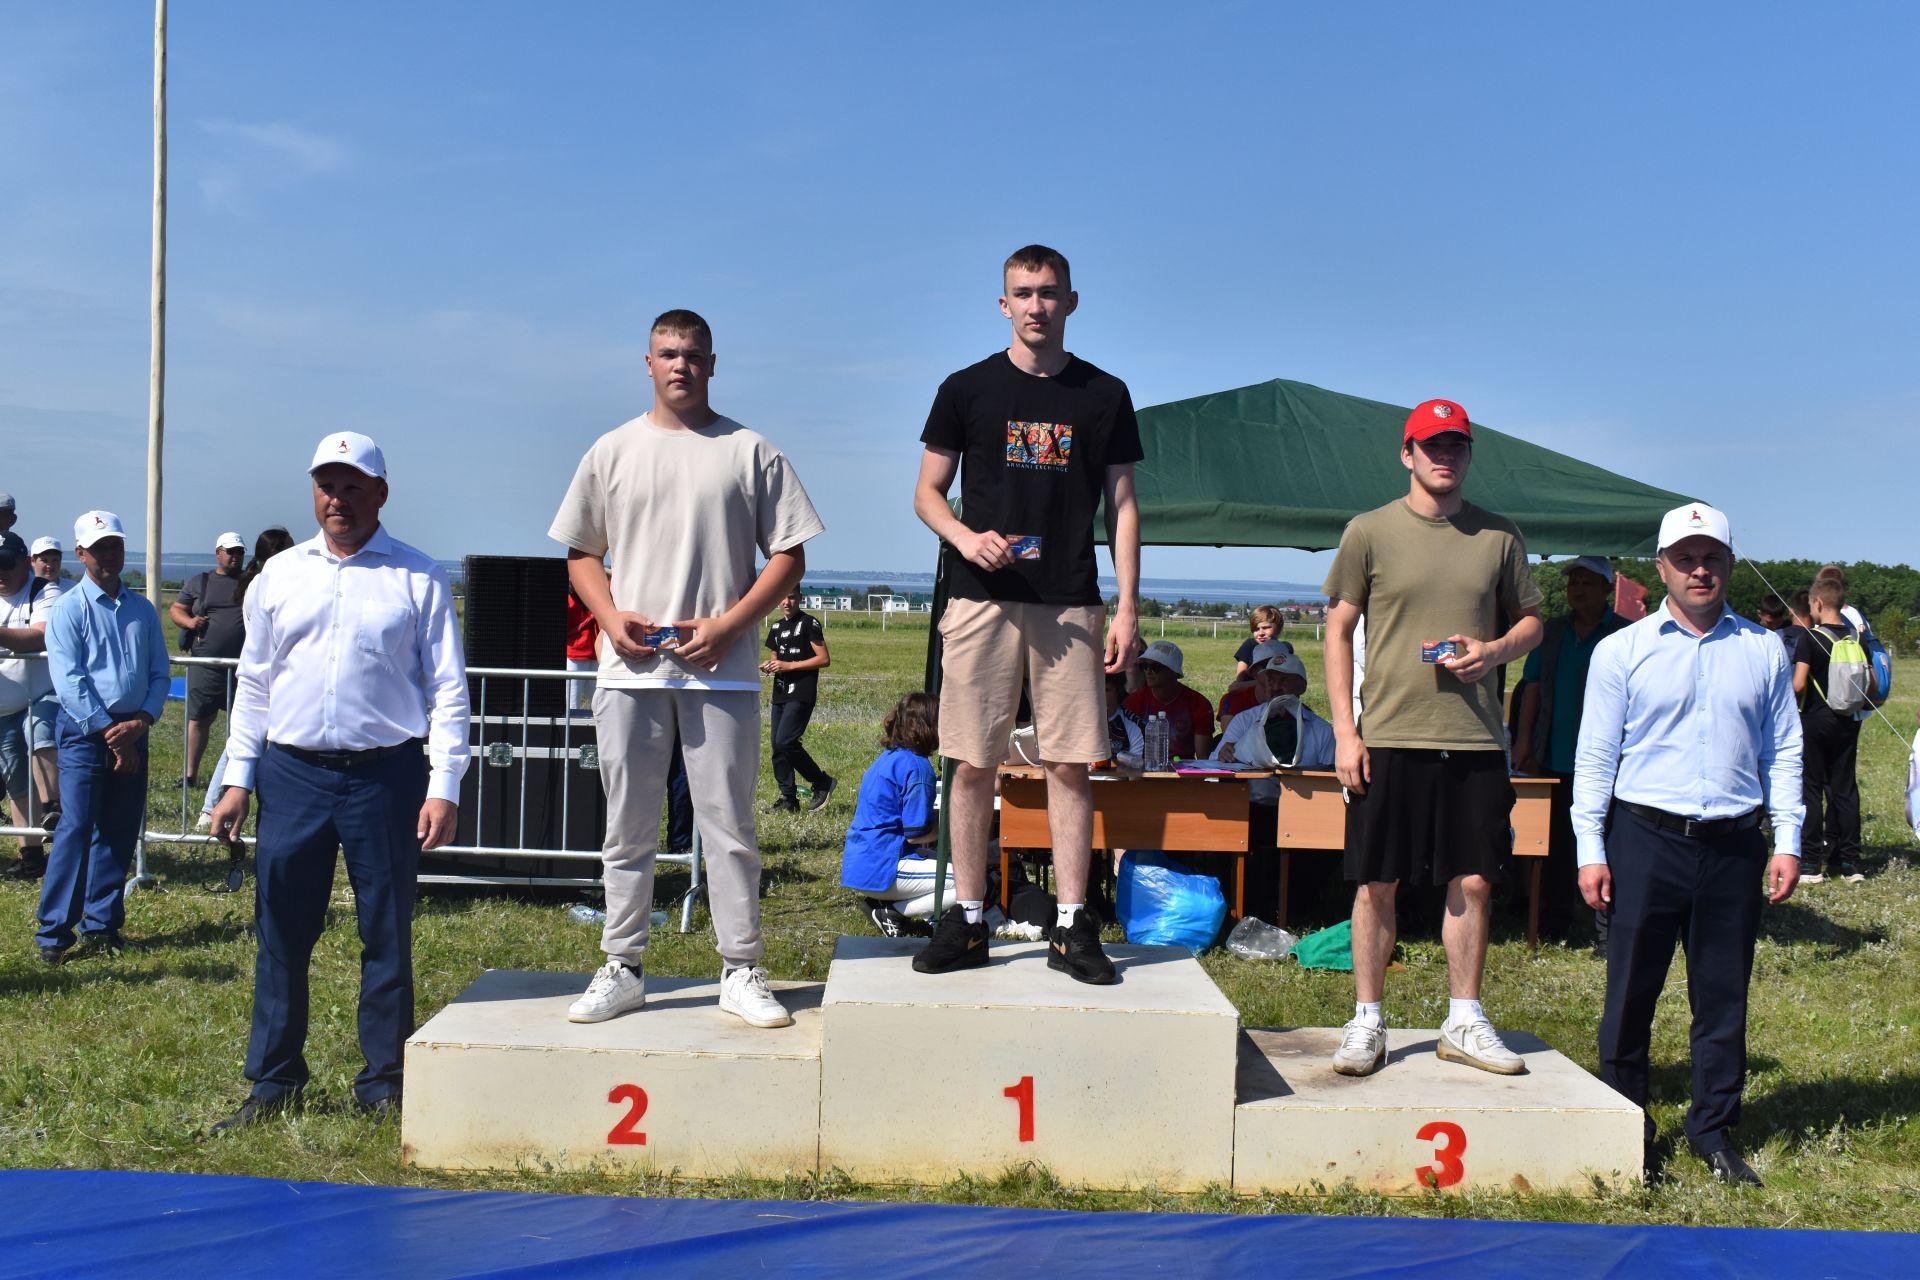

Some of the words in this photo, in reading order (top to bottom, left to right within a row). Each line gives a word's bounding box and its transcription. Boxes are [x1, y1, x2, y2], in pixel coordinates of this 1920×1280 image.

[607, 1084, 649, 1147] 2
[1003, 1076, 1035, 1143] 1
[1415, 1121, 1468, 1189] 3
